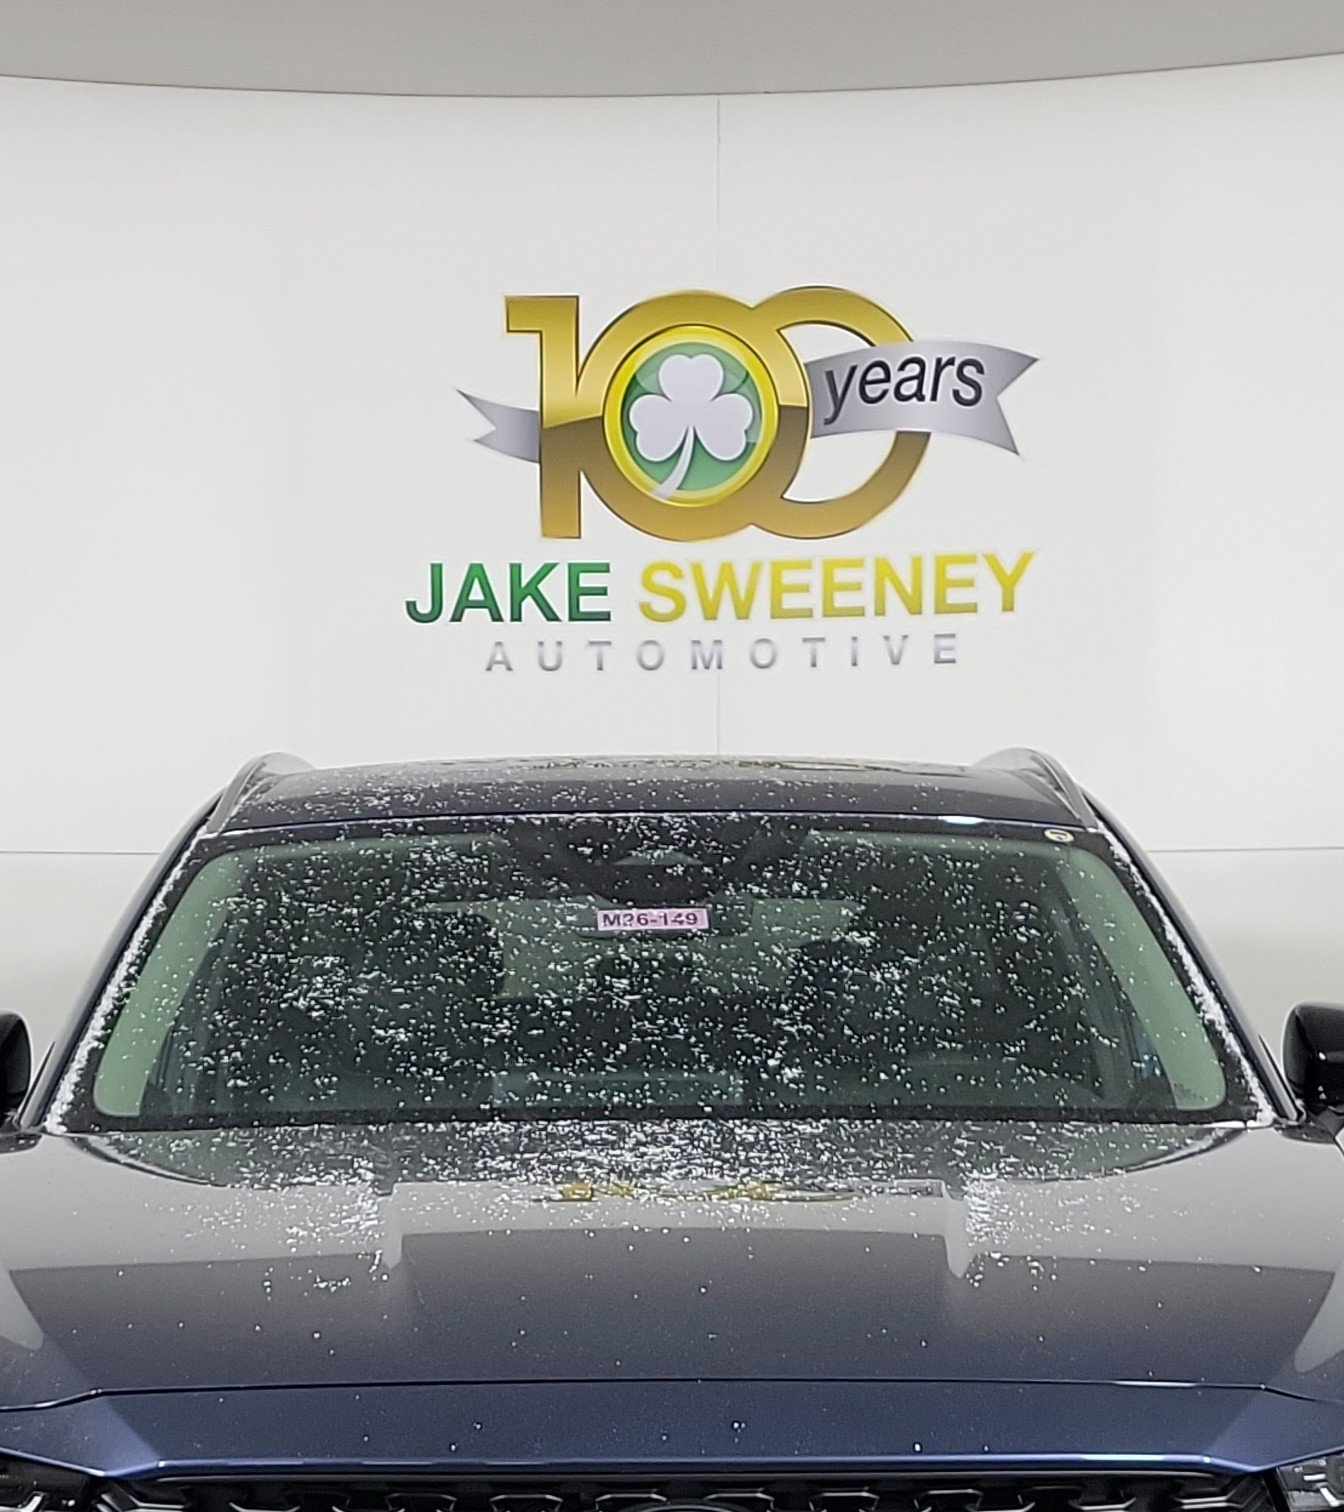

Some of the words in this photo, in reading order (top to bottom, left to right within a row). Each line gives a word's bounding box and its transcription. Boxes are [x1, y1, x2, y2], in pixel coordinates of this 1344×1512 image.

[504, 285, 930, 542] 100
[822, 354, 986, 426] years
[405, 561, 612, 624] JAKE
[638, 552, 1036, 622] SWEENEY
[485, 633, 959, 672] AUTOMOTIVE
